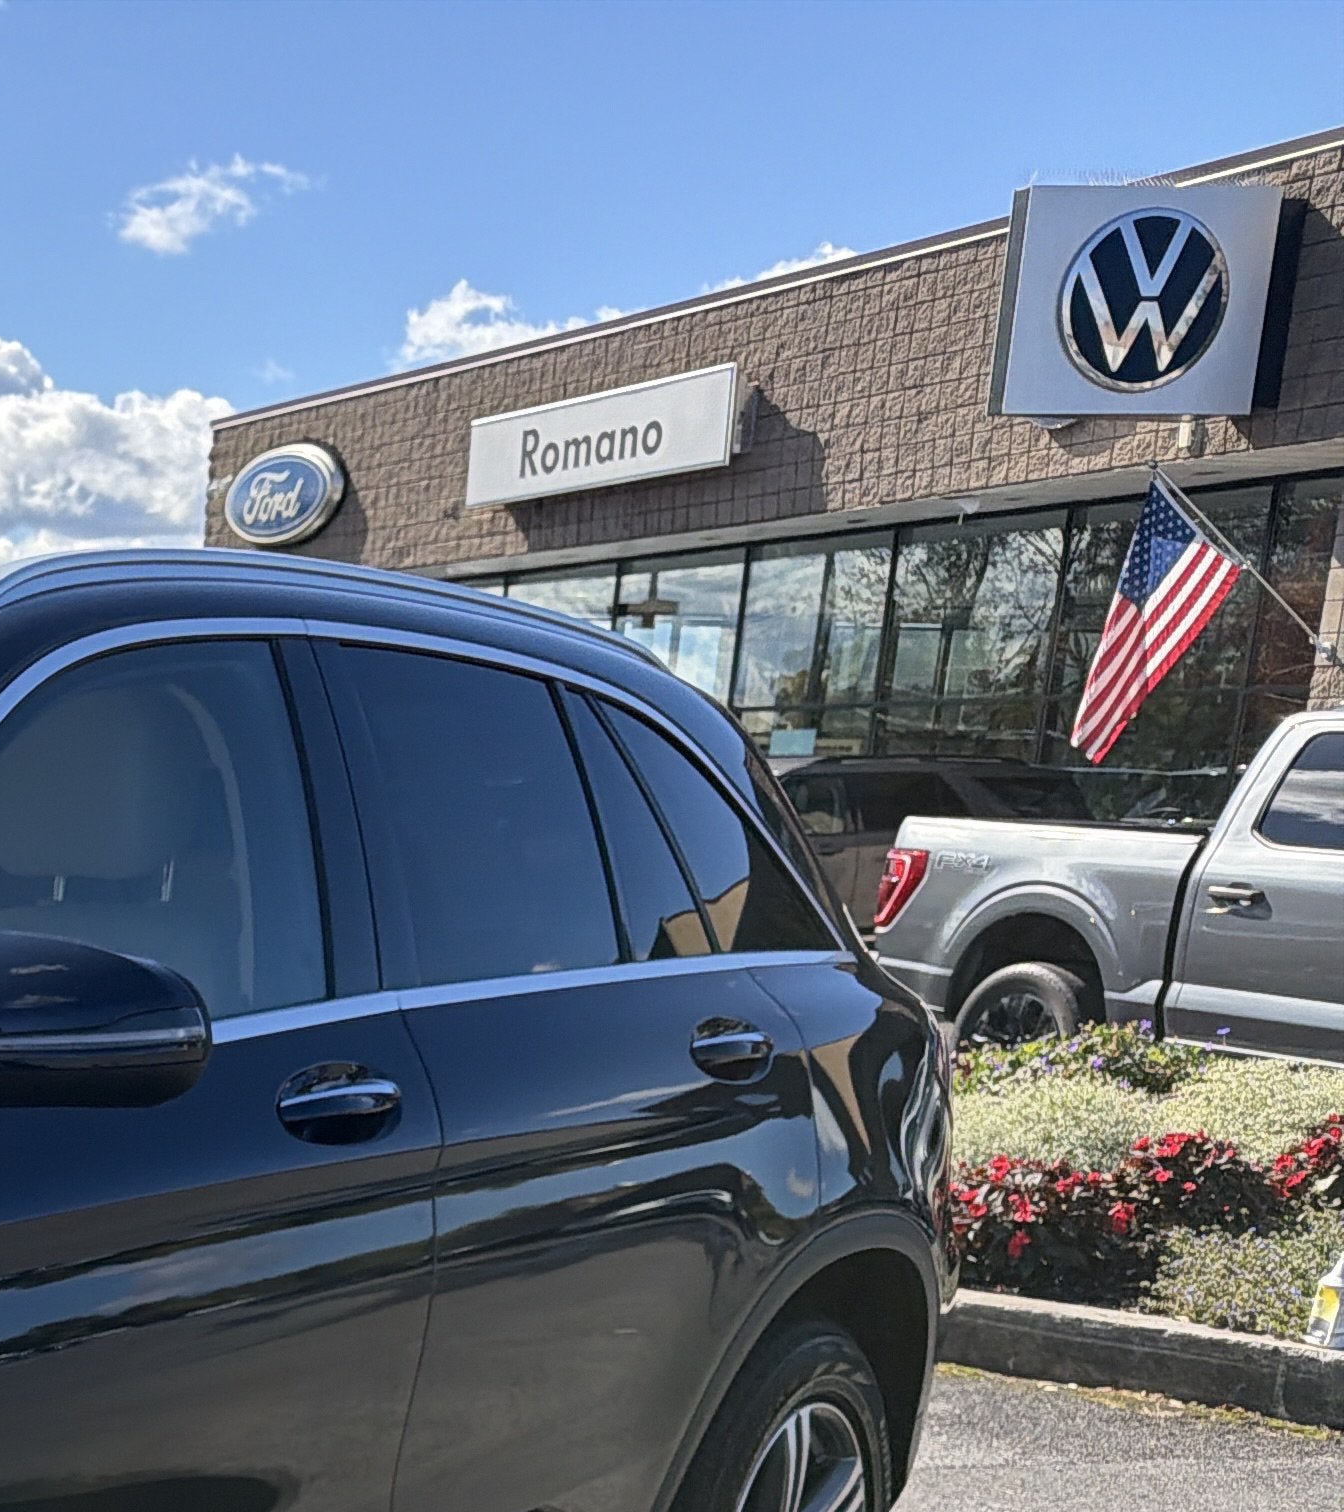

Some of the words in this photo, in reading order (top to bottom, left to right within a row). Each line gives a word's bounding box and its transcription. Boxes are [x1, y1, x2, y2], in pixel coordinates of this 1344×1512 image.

[518, 420, 663, 479] Romano
[242, 469, 305, 525] Ford
[934, 851, 992, 872] FX4
